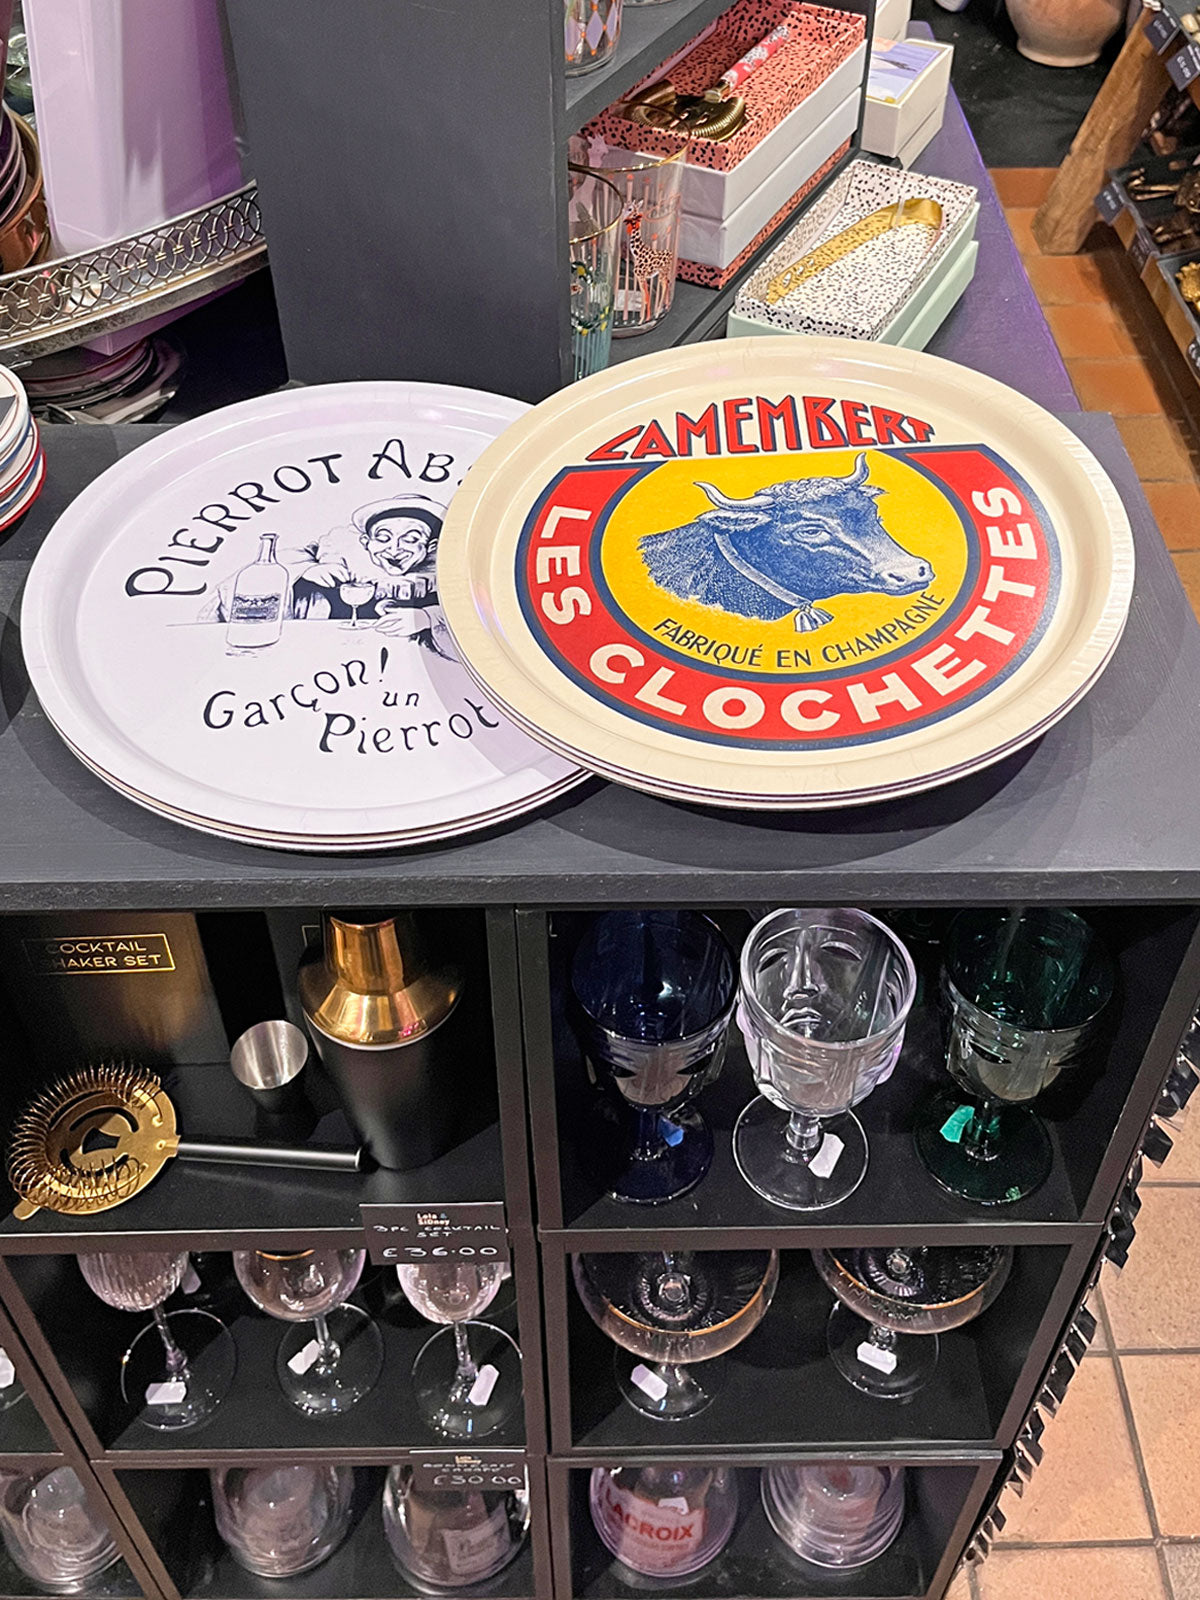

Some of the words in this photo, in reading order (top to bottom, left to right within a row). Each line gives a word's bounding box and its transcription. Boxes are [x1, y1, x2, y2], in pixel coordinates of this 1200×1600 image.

[586, 394, 936, 463] CAMEMBERT
[125, 453, 342, 597] PIERROT
[367, 438, 472, 487] AB
[535, 504, 592, 626] LES
[589, 485, 1038, 732] CLOCHETTES
[654, 618, 763, 668] FABRIQUÉ
[776, 649, 812, 668] EN
[822, 591, 945, 662] CHAMPAGNE
[202, 647, 389, 729] Garçon!
[382, 689, 420, 708] un
[318, 697, 500, 755] Pierrot
[44, 956, 118, 969] HAKER
[123, 955, 162, 967] SET
[46, 941, 148, 954] COCKTAIL
